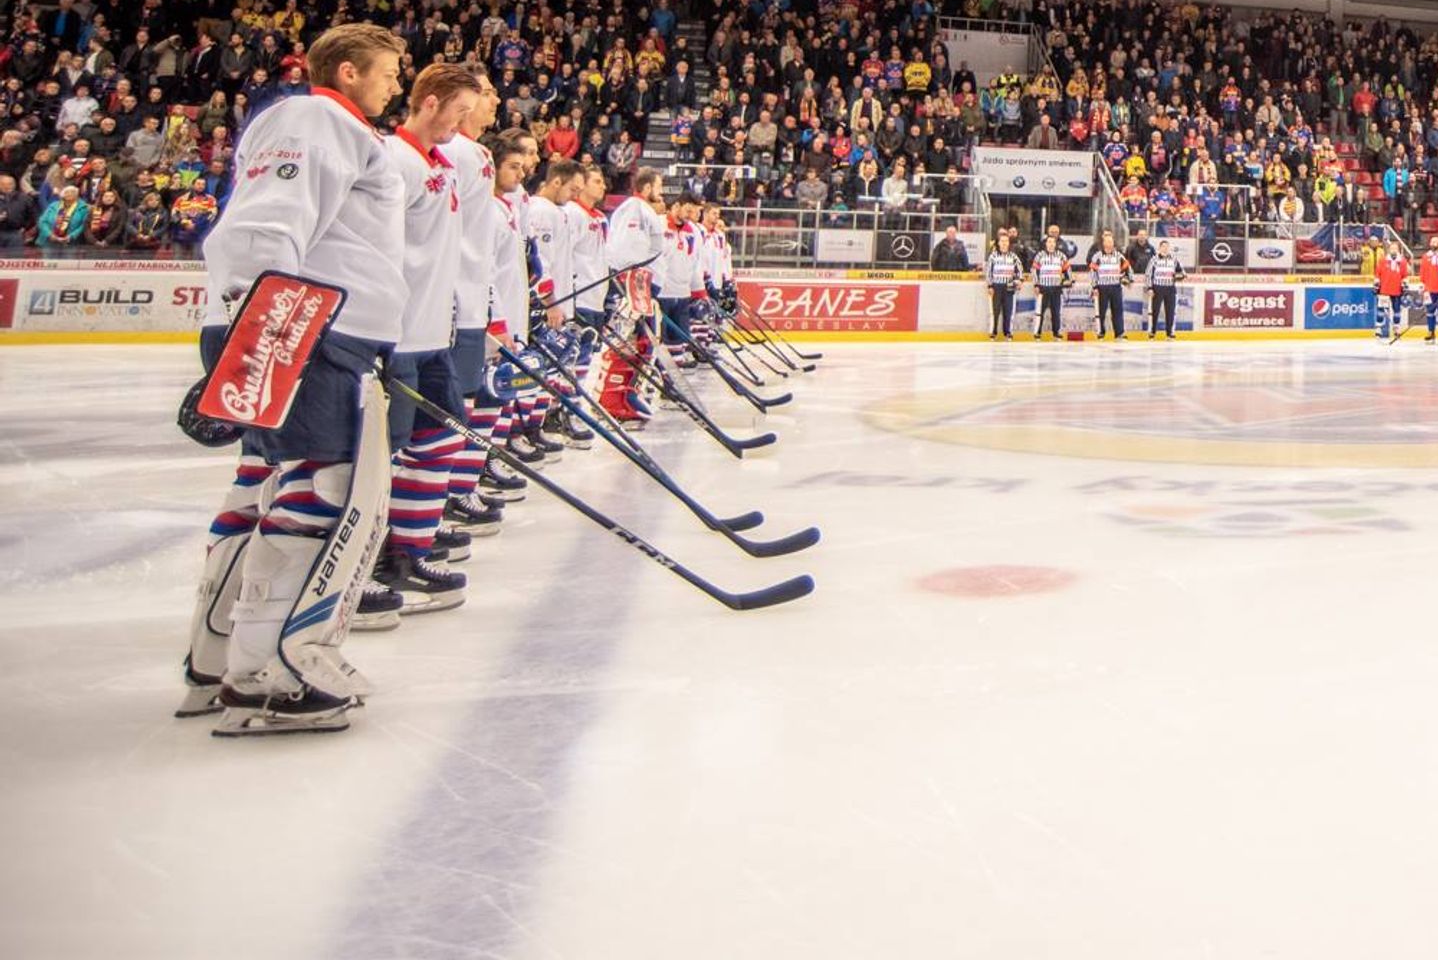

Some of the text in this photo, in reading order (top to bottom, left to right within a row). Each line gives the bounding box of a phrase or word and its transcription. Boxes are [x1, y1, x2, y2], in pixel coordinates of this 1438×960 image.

[31, 291, 52, 314] 4
[59, 289, 154, 304] BUILD
[757, 286, 900, 318] BANES
[1213, 291, 1287, 314] Pegast
[1331, 300, 1369, 317] pepsi
[272, 293, 323, 367] Budvar
[1213, 314, 1286, 327] Restaurace
[221, 285, 308, 421] Budweiser
